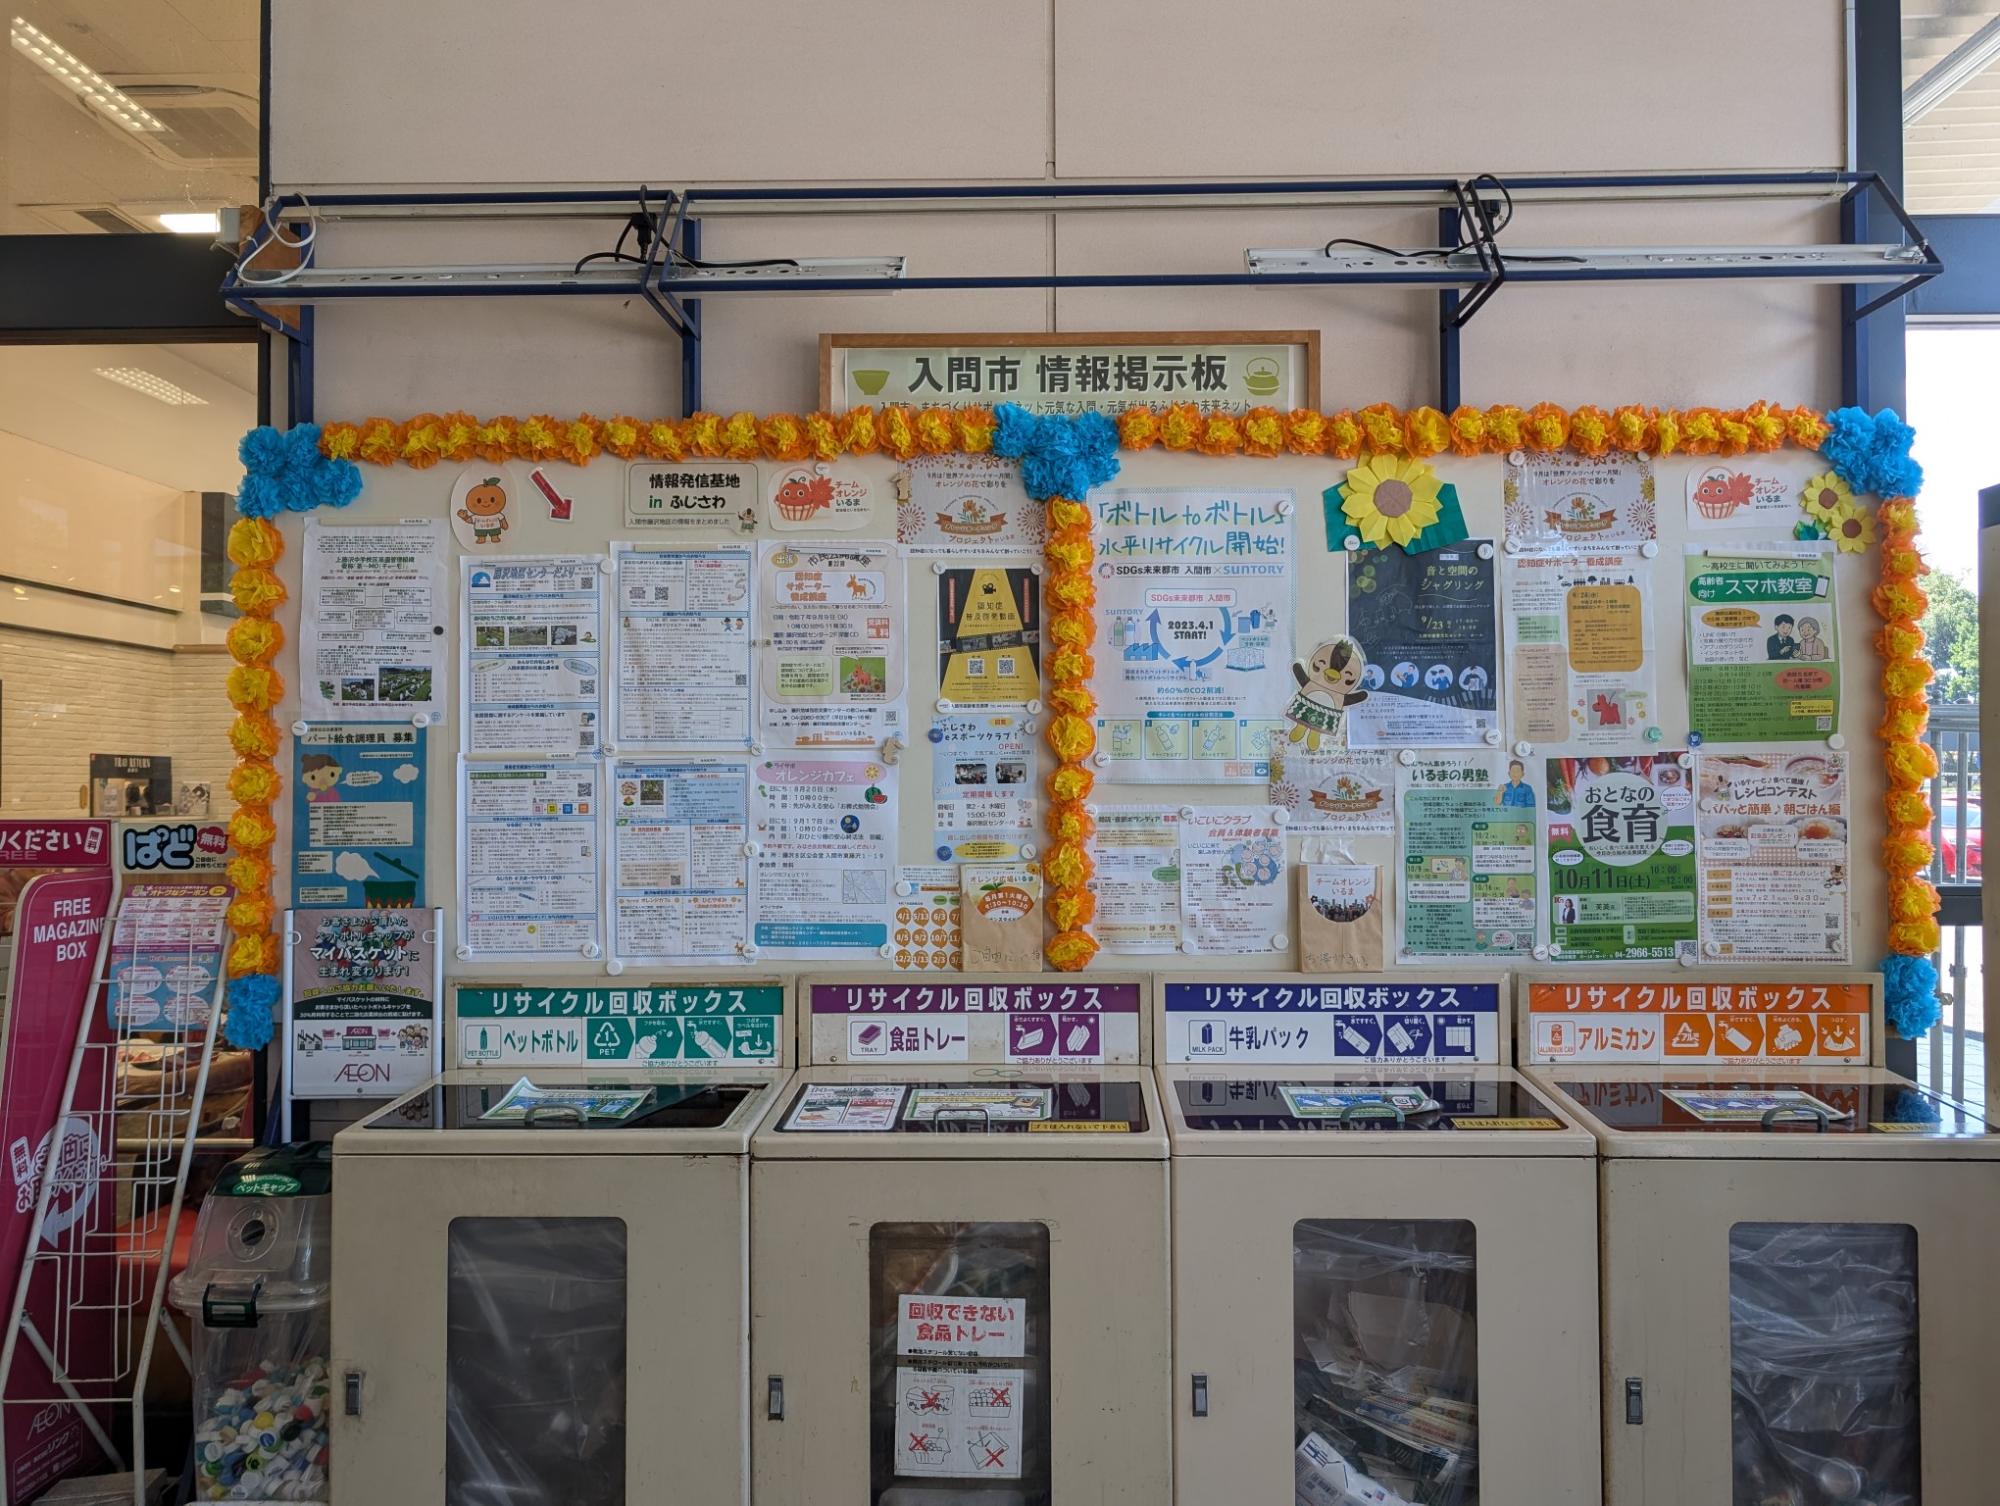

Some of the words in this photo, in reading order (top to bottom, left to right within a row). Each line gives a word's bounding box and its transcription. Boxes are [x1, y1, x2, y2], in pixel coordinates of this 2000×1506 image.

[908, 355, 1020, 393] 入間市
[1036, 355, 1229, 393] 情報掲示板
[649, 473, 740, 489] 情報発信基地
[1755, 485, 1788, 494] オレンジ
[649, 495, 662, 508] in
[670, 495, 726, 509] ふじさわ
[836, 498, 861, 506] いるま
[1756, 495, 1782, 503] いるま
[1183, 505, 1201, 525] to
[1420, 579, 1485, 591] ジャグリング
[1725, 576, 1813, 595] スマホ教室
[1698, 589, 1715, 599] 向け
[1167, 620, 1214, 631] 2023.4.1
[1173, 631, 1208, 640] START!
[393, 732, 414, 743] 募集
[775, 769, 855, 783] オレンジカフェ
[1412, 769, 1489, 782] いるまの男塾
[1585, 786, 1654, 804] おとなの
[1734, 786, 1817, 801] レシピコンテスト
[1551, 827, 1570, 837] 無料
[1580, 803, 1661, 844] 食育
[124, 825, 196, 868] ぱど
[200, 833, 226, 849] 無料
[1331, 887, 1355, 896] いるま
[53, 897, 91, 918] FREE
[314, 931, 415, 942] ペットボトルキャップが
[56, 941, 87, 962] BOX
[309, 946, 420, 961] マイバスケットに
[492, 990, 747, 1015] リサイクル回収ボックス
[846, 986, 1103, 1011] リサイクル回収ボックス
[1204, 987, 1461, 1009] リサイクル回収ボックス
[1565, 986, 1832, 1010] リサイクル回収ボックス
[503, 1029, 579, 1053] ペットボトル
[889, 1026, 965, 1052] 食品トレー
[1228, 1026, 1310, 1050] 牛乳パック
[1578, 1026, 1656, 1051] アルミカン
[599, 1048, 615, 1056] PET
[908, 1302, 1015, 1321] 回収できない
[916, 1322, 1005, 1343] 食品トレー
